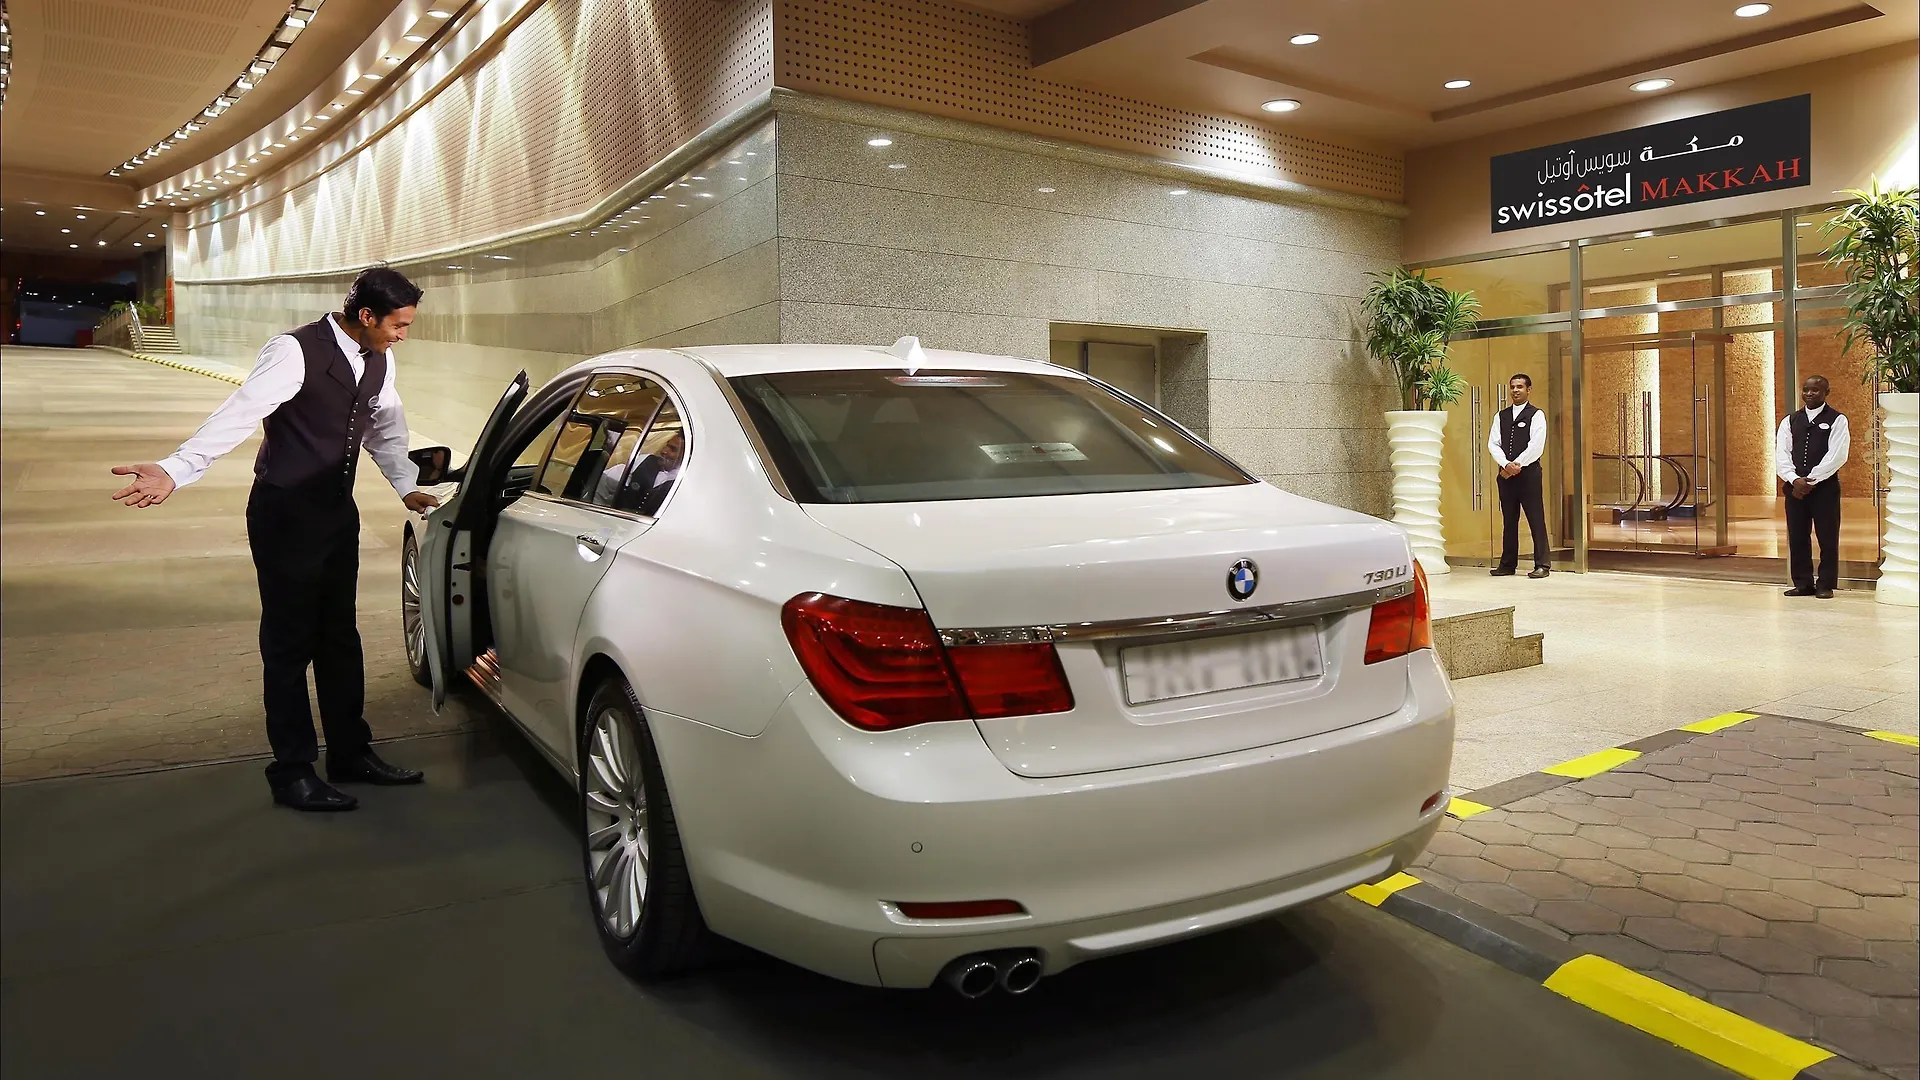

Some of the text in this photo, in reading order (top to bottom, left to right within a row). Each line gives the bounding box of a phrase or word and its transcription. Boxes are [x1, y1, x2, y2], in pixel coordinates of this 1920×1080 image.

[1576, 149, 1631, 178] سويس
[1497, 158, 1800, 224] swissôtel MAKKAH
